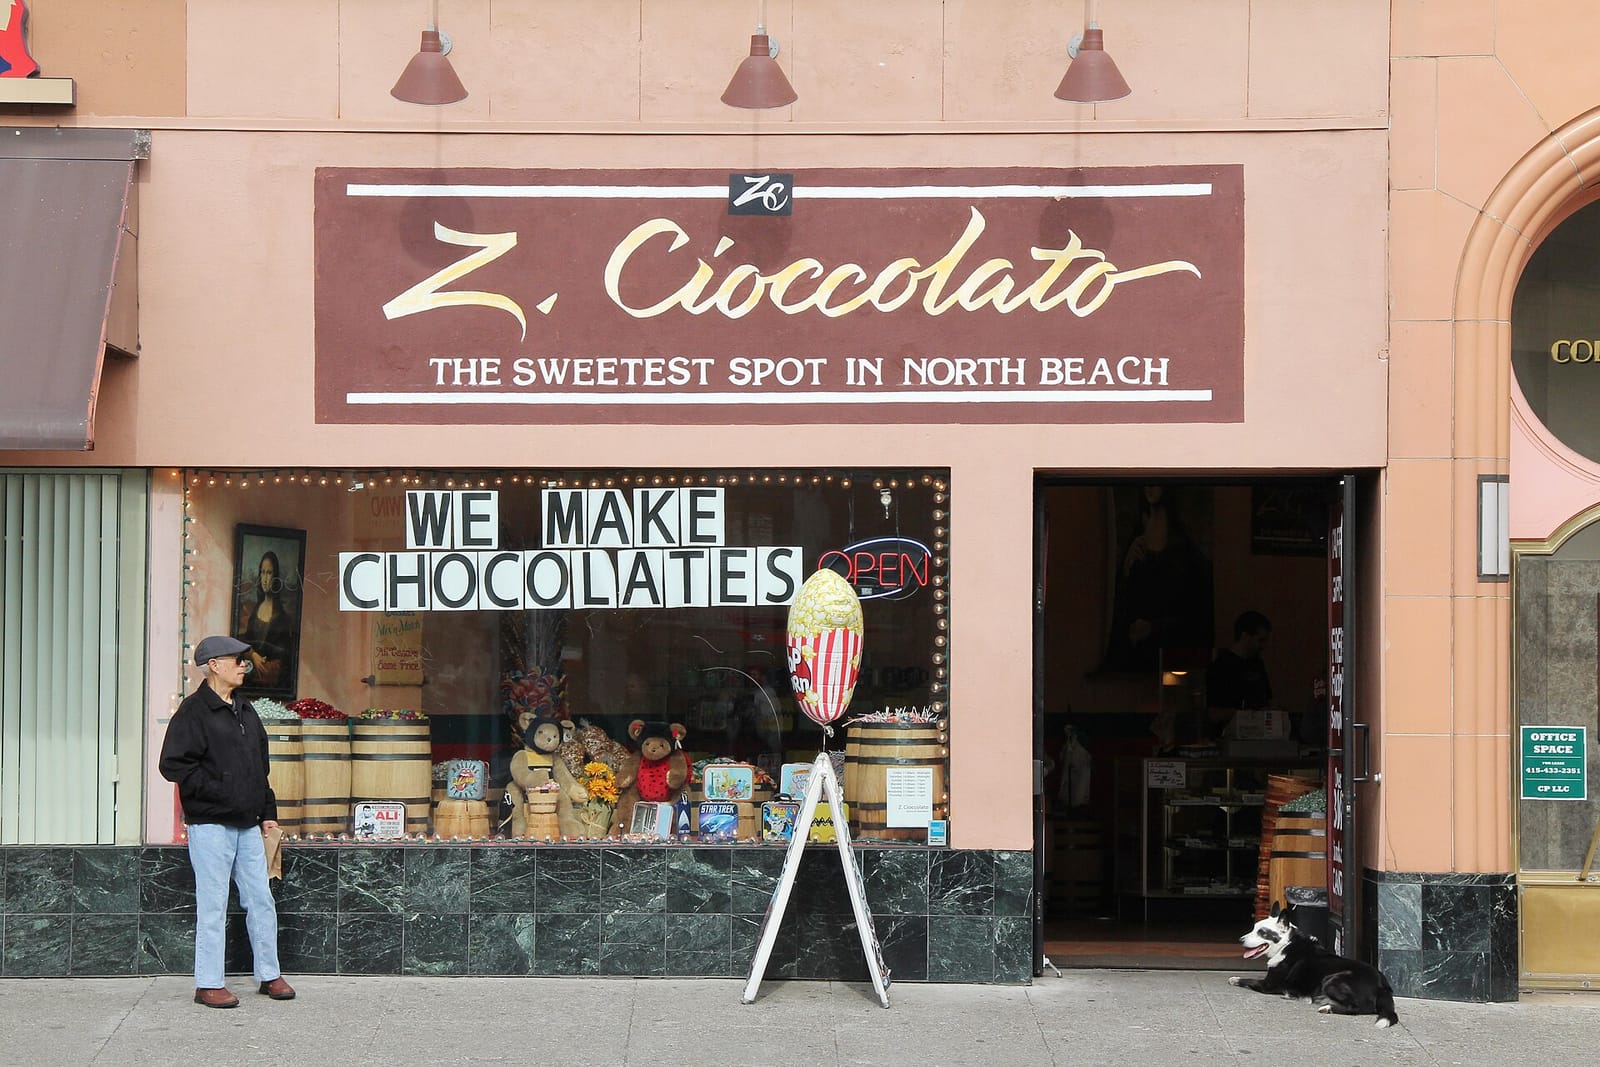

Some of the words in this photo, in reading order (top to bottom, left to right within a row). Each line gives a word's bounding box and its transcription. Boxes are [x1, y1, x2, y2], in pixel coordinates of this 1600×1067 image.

[382, 220, 558, 342] Z.
[604, 205, 1202, 320] Cioccolato
[429, 357, 501, 386] THE
[512, 356, 715, 386] SWEETEST
[728, 356, 828, 387] SPOT
[845, 357, 884, 386] IN
[902, 357, 1026, 386] NORTH
[1038, 355, 1170, 386] BEACH
[407, 491, 493, 547] WE
[546, 488, 717, 546] MAKE
[342, 547, 795, 608] CHOCOLATES
[817, 550, 929, 586] OPEN
[1530, 732, 1577, 742] OFFICE
[1533, 745, 1574, 754] SPACE
[375, 811, 398, 820] ALI
[700, 804, 718, 814] STAR
[718, 804, 735, 814] TREK
